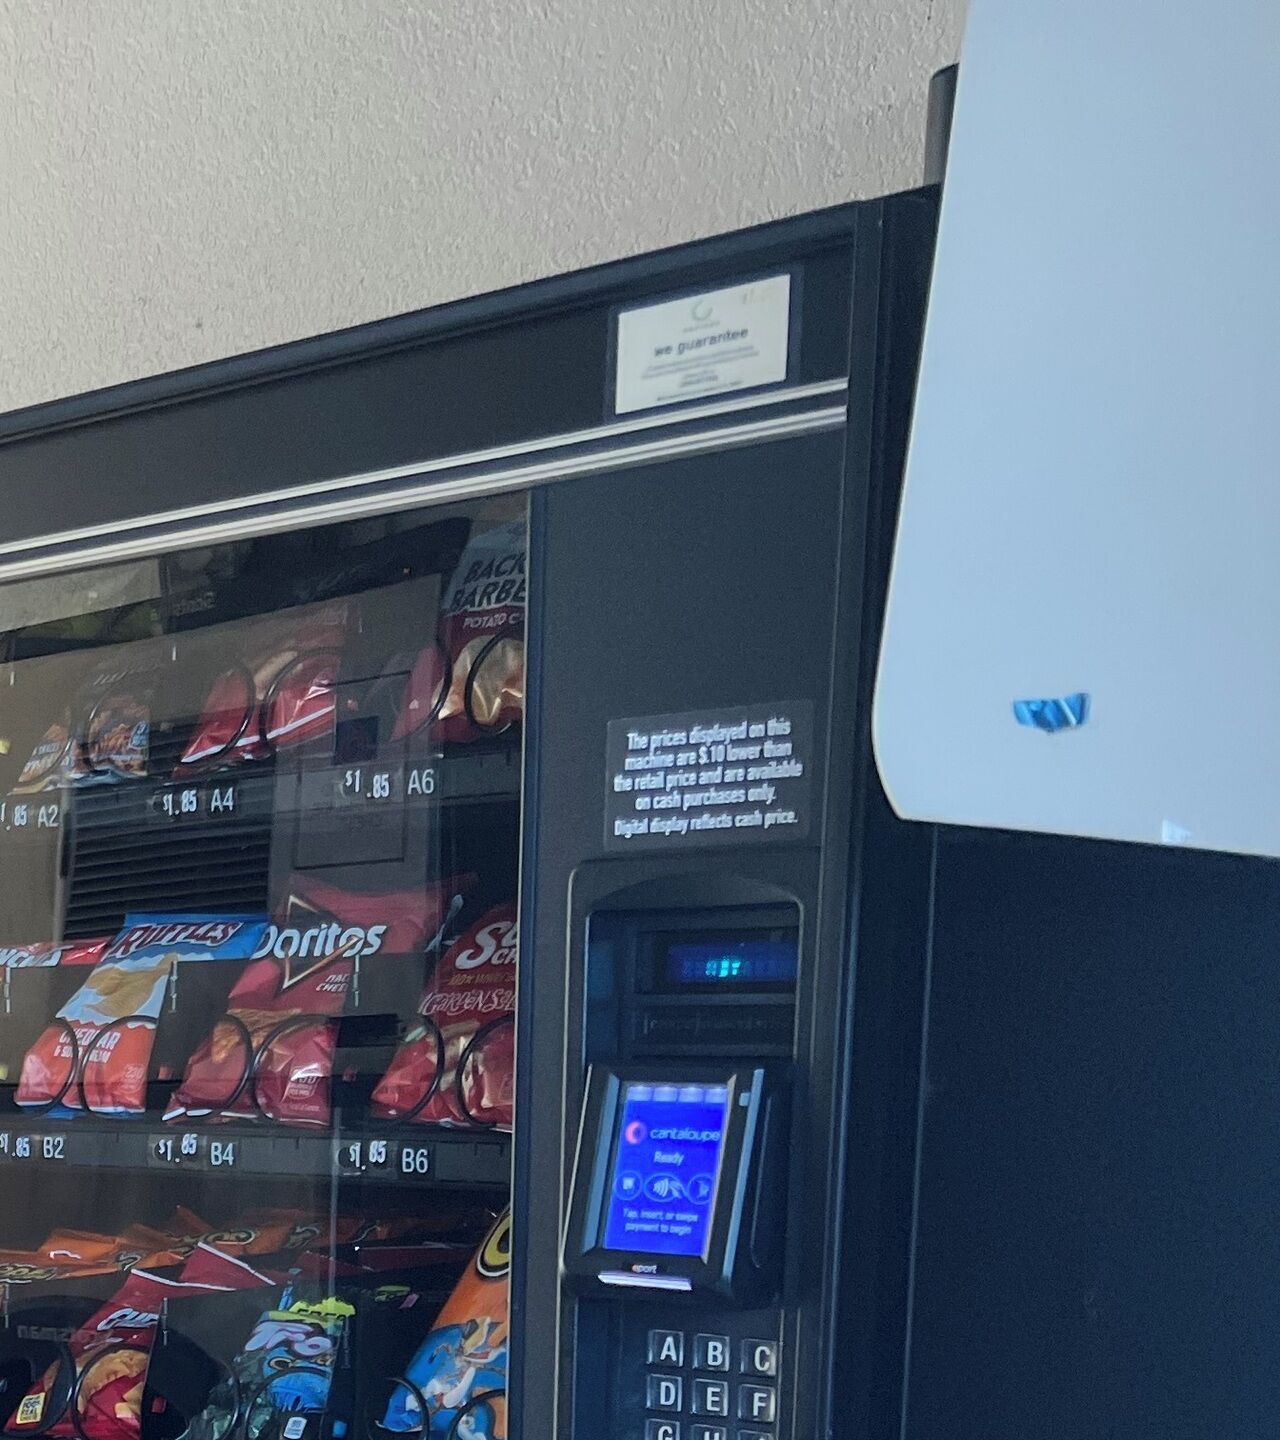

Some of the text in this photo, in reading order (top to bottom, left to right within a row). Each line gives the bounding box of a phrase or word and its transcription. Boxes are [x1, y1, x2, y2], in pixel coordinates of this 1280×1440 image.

[654, 327, 749, 357] we guarantee
[463, 613, 507, 629] POTATO
[627, 717, 791, 754] The prices displayed on this
[625, 741, 792, 770] machine are lower than
[407, 769, 435, 794] A6
[614, 759, 803, 792] the retail price and are available
[210, 787, 234, 812] A4
[635, 783, 776, 811] on cash purchases only.
[38, 805, 59, 828] A2
[614, 808, 798, 838] Digital display reflects cash price.
[250, 922, 388, 959] Doritos
[650, 1126, 721, 1142] cantaloupe
[43, 1137, 65, 1159] B2
[211, 1142, 234, 1166] B4
[653, 1150, 684, 1166] Ready
[402, 1149, 428, 1173] B6
[625, 1223, 668, 1233] payment to
[660, 1336, 770, 1372] A B C
[660, 1381, 768, 1417] D E F
